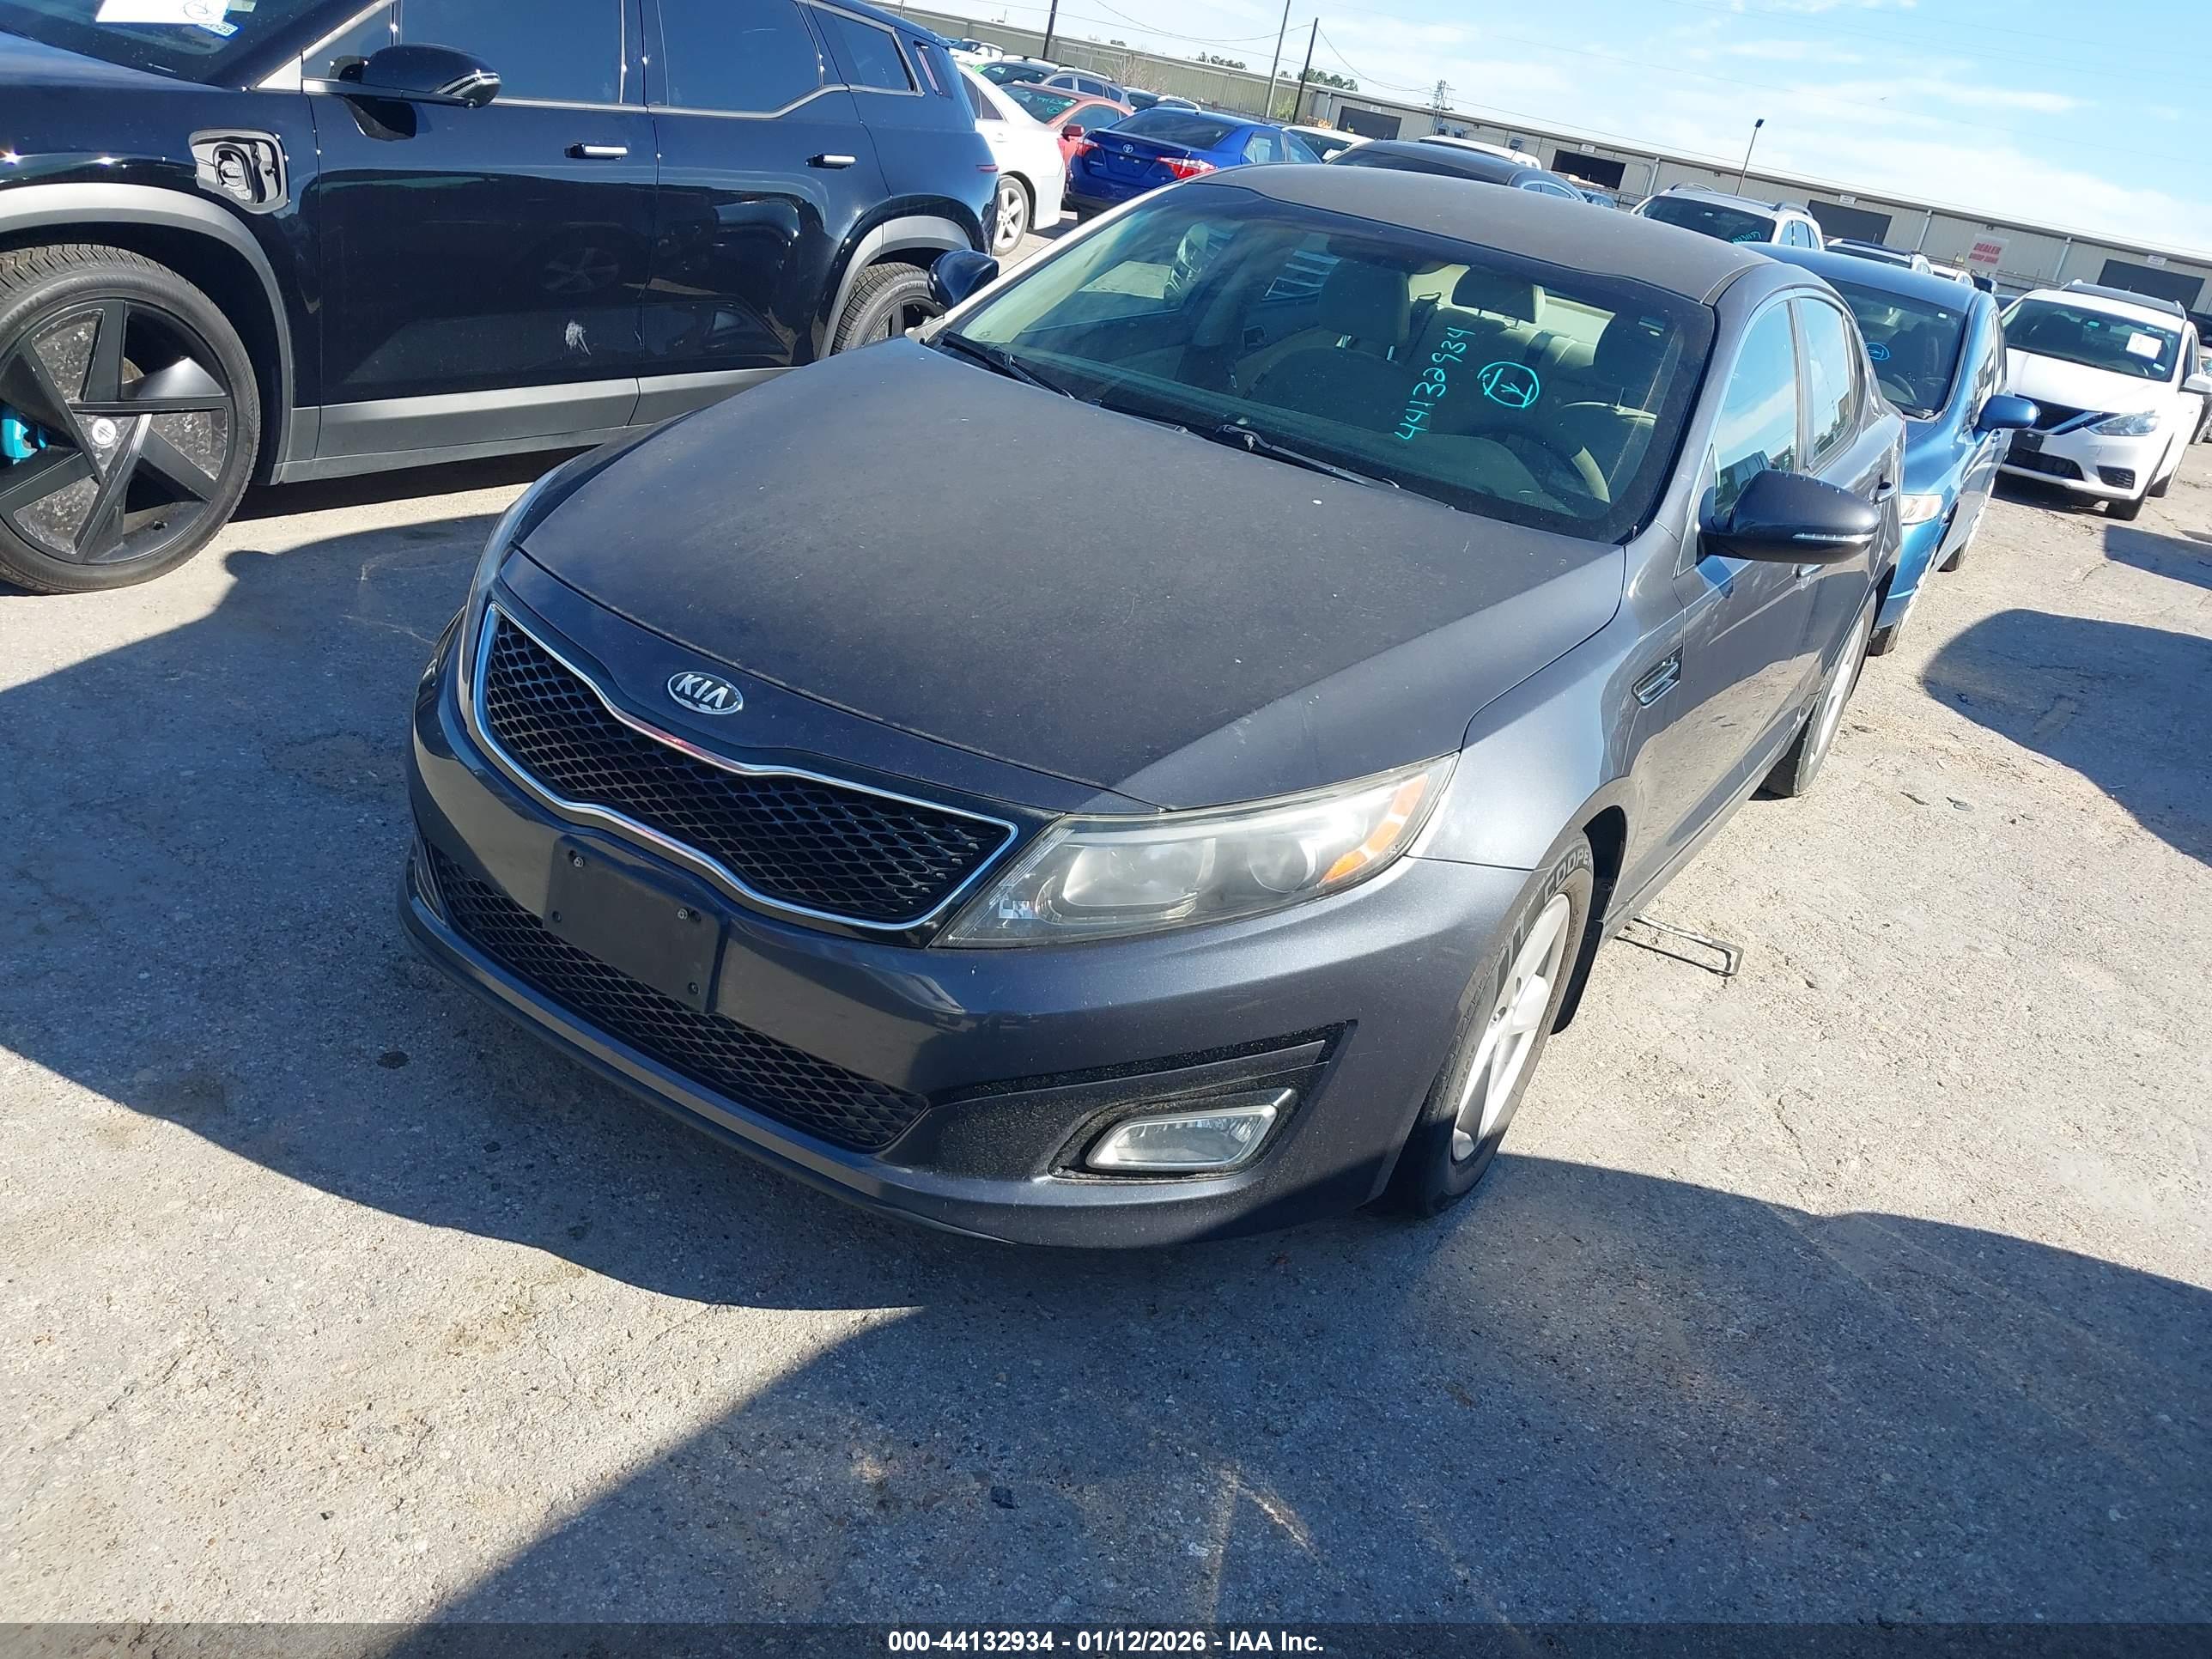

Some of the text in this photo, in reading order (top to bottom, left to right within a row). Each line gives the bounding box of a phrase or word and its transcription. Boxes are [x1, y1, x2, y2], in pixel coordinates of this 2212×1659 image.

[1973, 242, 2002, 254] DEALER
[1394, 326, 1476, 441] 44132934
[674, 673, 729, 708] KIA
